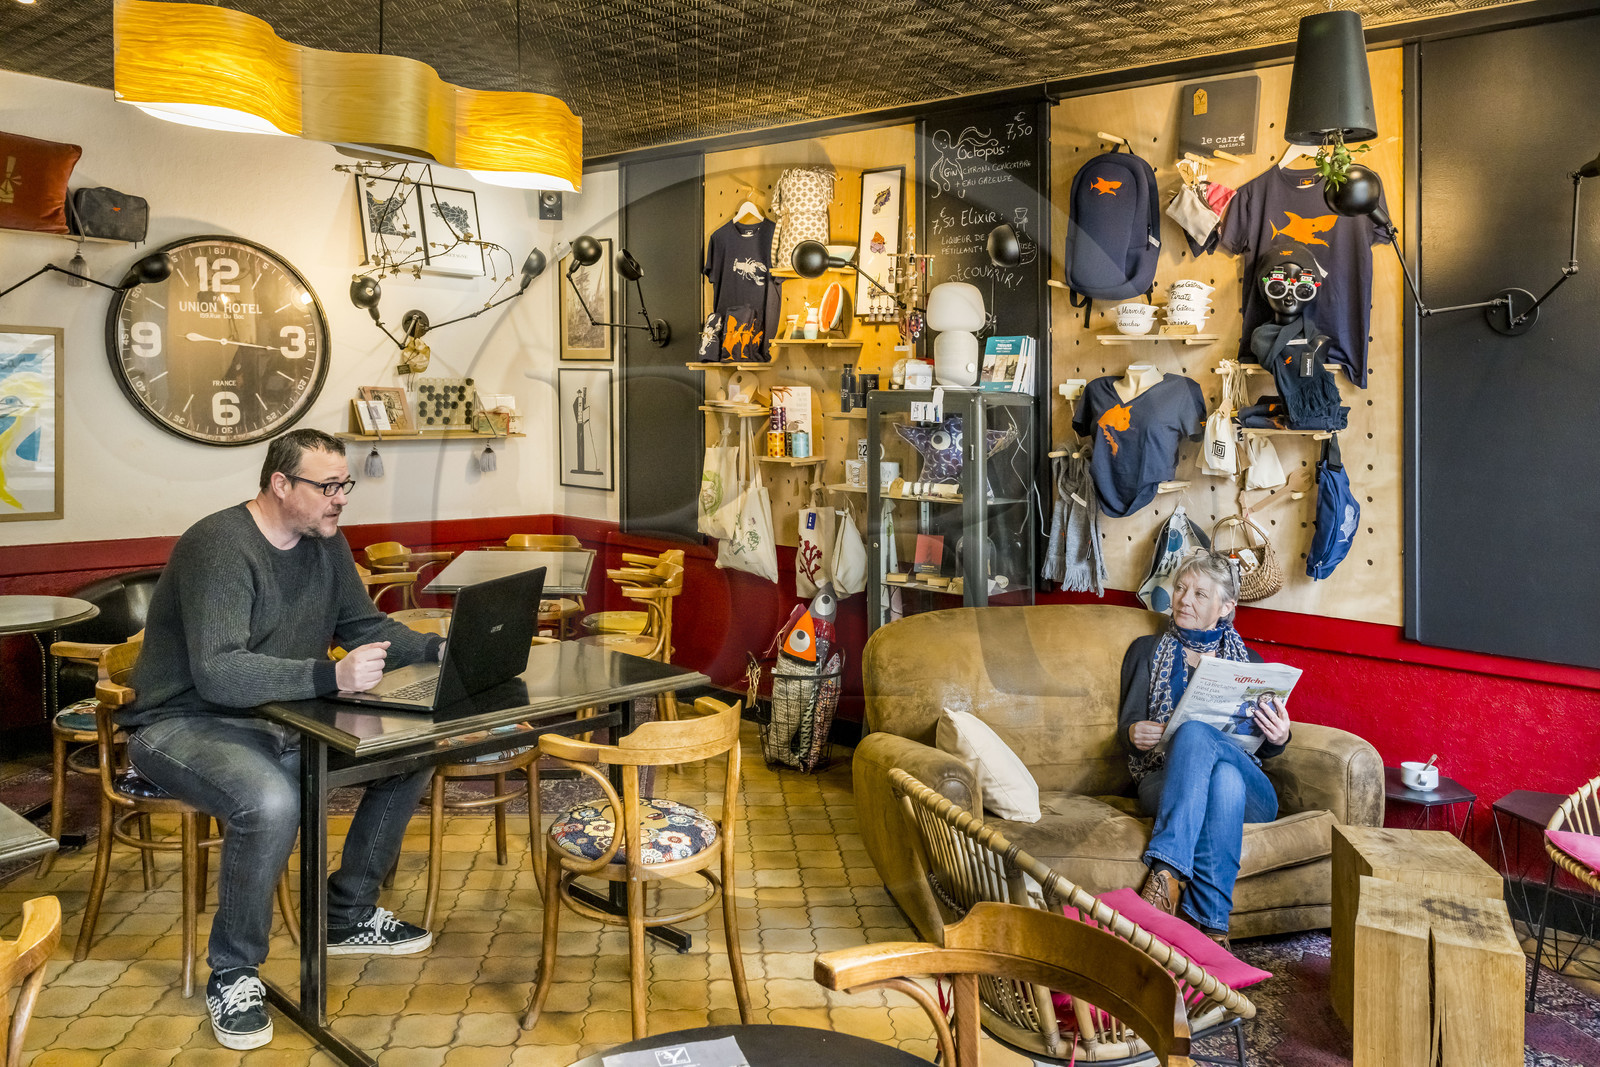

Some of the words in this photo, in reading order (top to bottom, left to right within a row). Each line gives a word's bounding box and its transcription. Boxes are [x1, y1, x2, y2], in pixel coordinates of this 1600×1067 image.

[1005, 123, 1033, 140] 7,50
[1201, 136, 1213, 145] le
[1215, 133, 1246, 144] carré
[962, 178, 976, 188] EAU
[978, 174, 1014, 185] GAZEUSE
[932, 216, 955, 235] 7,50
[974, 233, 986, 242] DE
[194, 256, 241, 293] 12
[179, 301, 218, 313] UNION
[224, 302, 263, 315] HOTEL
[130, 321, 162, 358] 9
[279, 325, 307, 359] 3
[212, 391, 241, 426] 6
[1234, 675, 1266, 684] affiche
